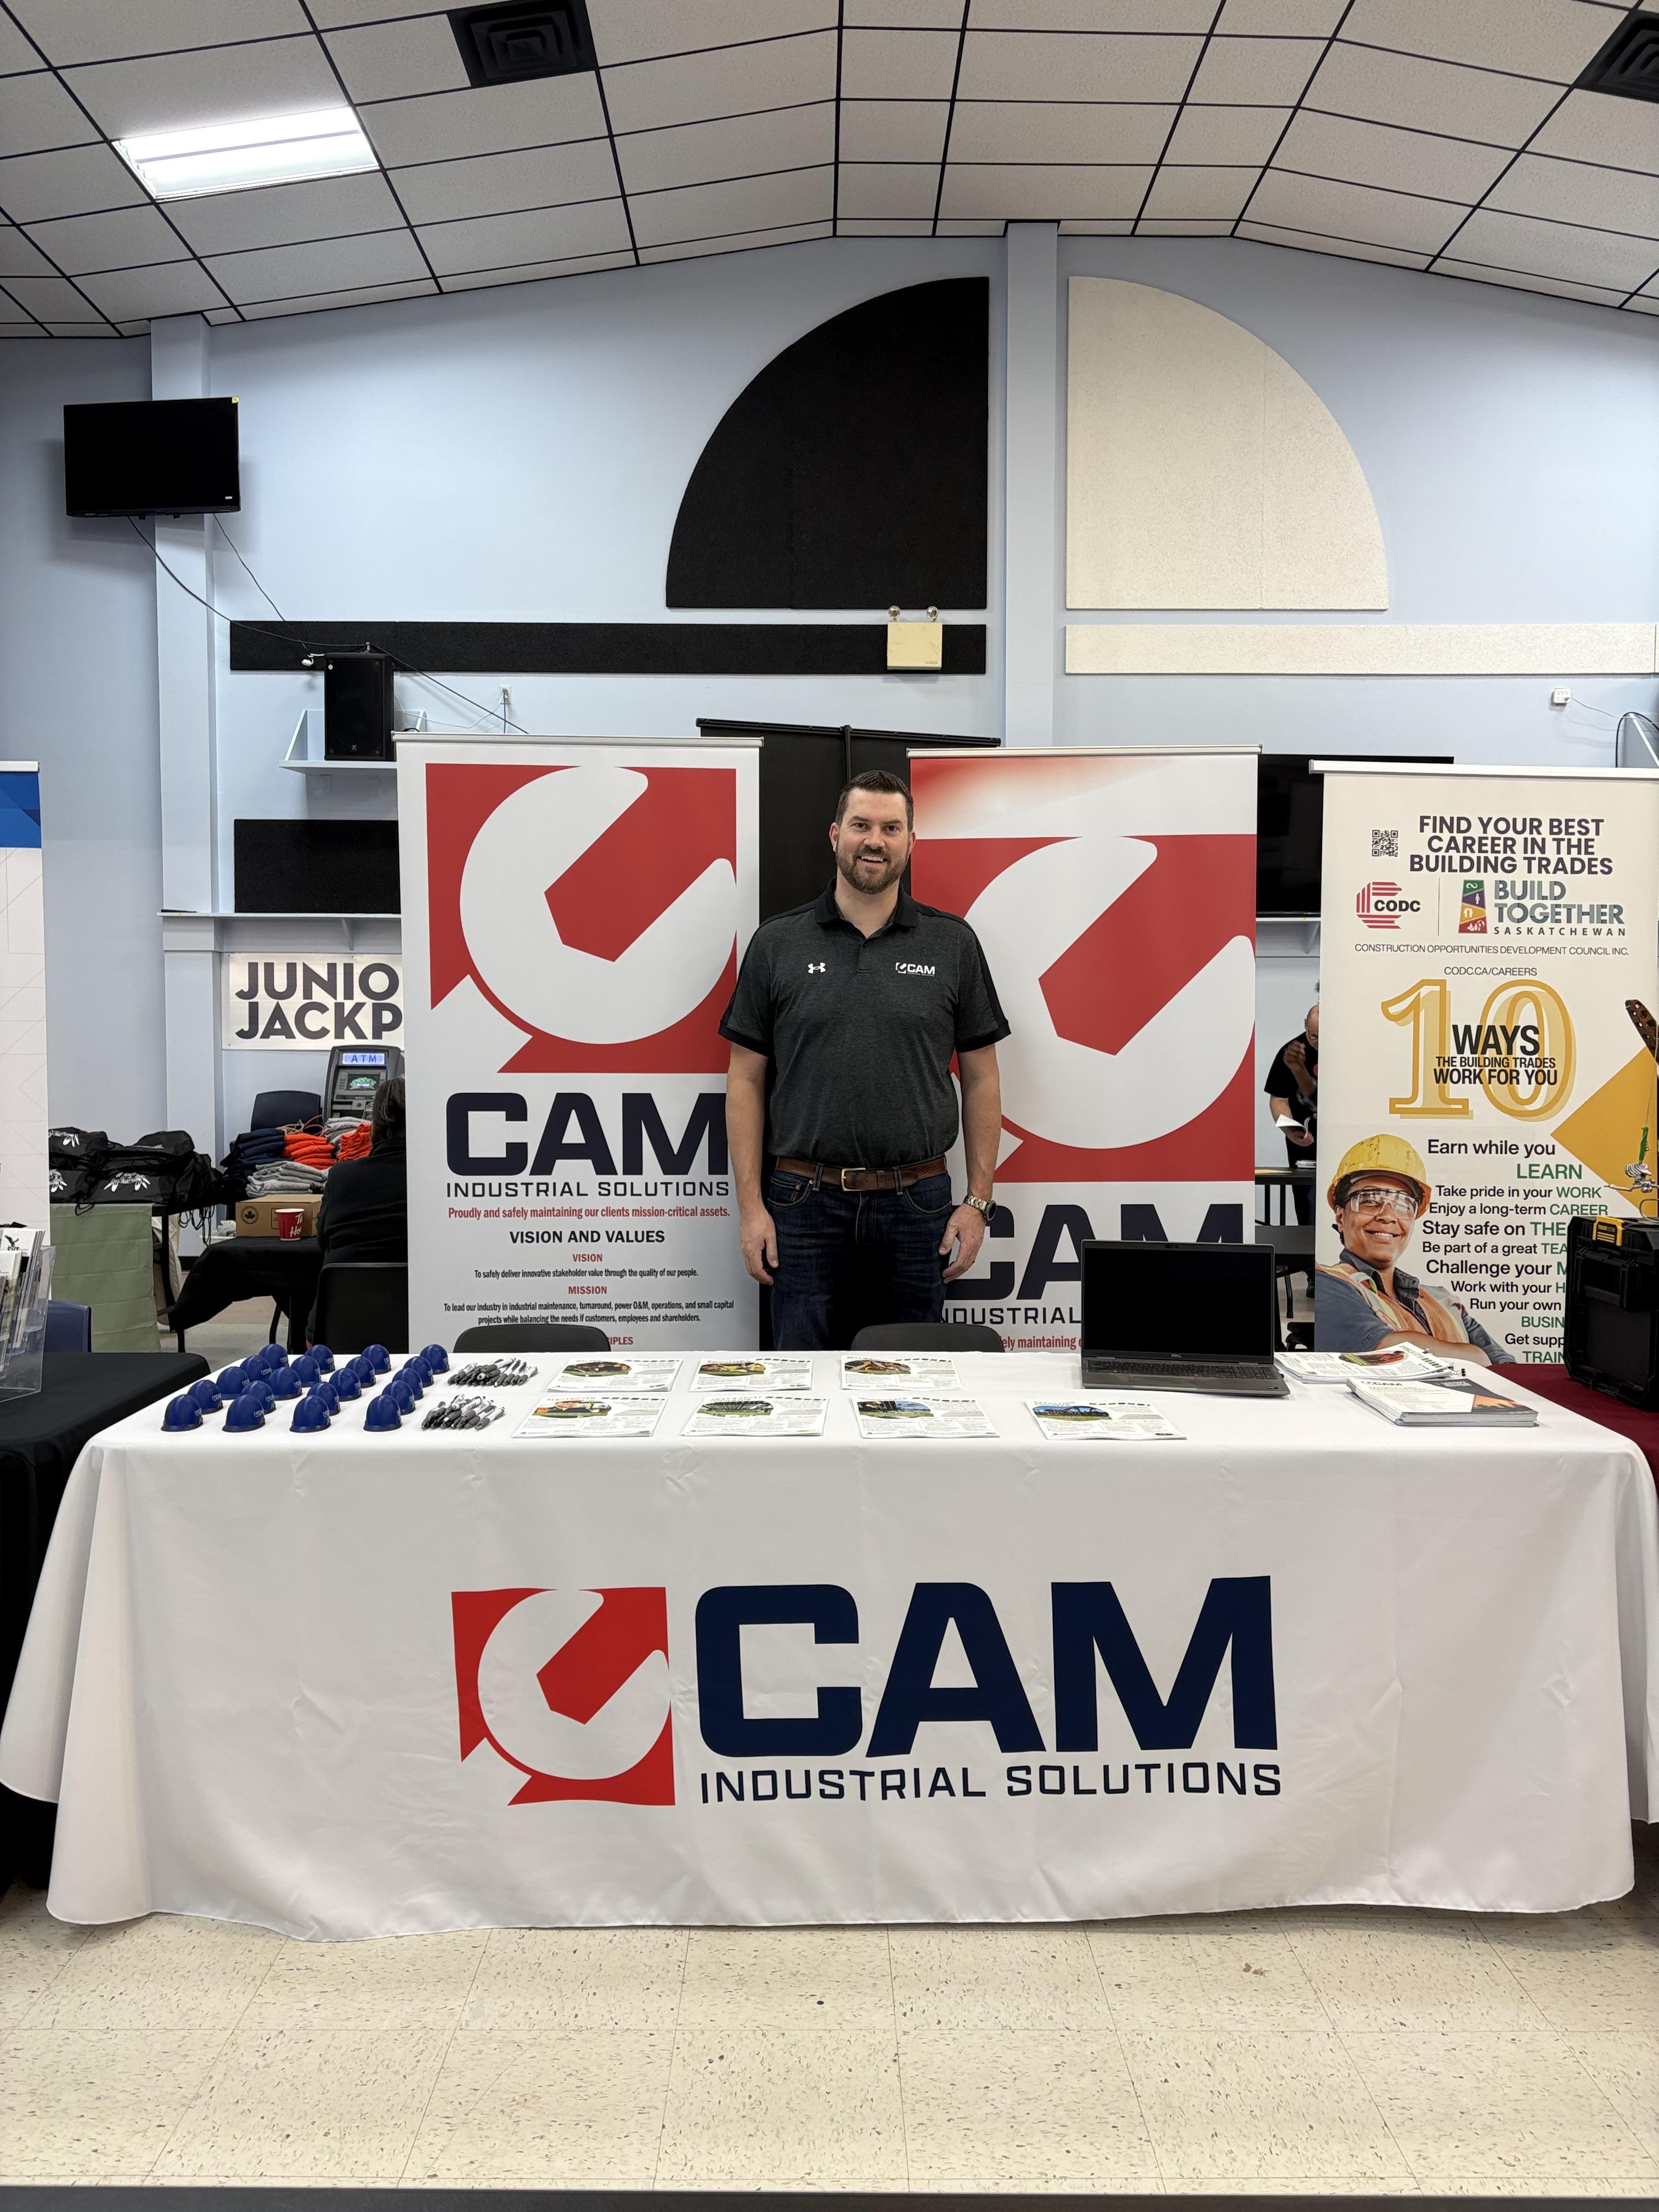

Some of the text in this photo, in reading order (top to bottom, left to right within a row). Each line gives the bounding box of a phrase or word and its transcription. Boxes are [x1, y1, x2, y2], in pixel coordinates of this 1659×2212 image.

[1420, 816, 1604, 836] FIND YOUR BEST
[1427, 836, 1595, 855] CAREER IN THE
[1410, 854, 1612, 874] BUILDING TRADES
[1494, 880, 1566, 900] BUILD
[1374, 900, 1421, 912] CODC
[1494, 903, 1625, 924] TOGETHER
[1494, 927, 1626, 936] SASKATCHEWAN
[1355, 944, 1629, 956] CONSTRUCTION OPPORTUNITIES DEVELOPMENT COUNCIL INC.
[907, 964, 935, 974] CAM
[1444, 967, 1537, 976] CODC.CA/CAREERS
[235, 962, 399, 1001] JUNIO
[235, 1001, 403, 1040] JACKP
[1452, 1025, 1540, 1056] WAYS
[1436, 1057, 1556, 1068] THE BUILDING TRADES
[1434, 1069, 1558, 1085] WORK FOR YOU
[446, 1093, 729, 1176] CAM
[1428, 1139, 1555, 1159] Earn while you
[1516, 1164, 1582, 1180] LEARN
[447, 1182, 729, 1197] INDUSTRIAL SOLUTIONS
[1436, 1186, 1602, 1200] Take pride in your WORK
[448, 1206, 730, 1220] Proudly and safely maintaining our clients mission-critical assets.
[1429, 1203, 1465, 1216] Enjoy
[1480, 1203, 1546, 1217] long-term
[1550, 1204, 1608, 1215] CAREER
[1423, 1221, 1566, 1238] Stay safe on THE
[509, 1231, 665, 1243] VISION AND VALUES
[1423, 1242, 1440, 1253] Be
[1444, 1242, 1471, 1255] part
[1474, 1242, 1487, 1254] of
[1502, 1243, 1537, 1256] great
[482, 1269, 500, 1279] safely
[501, 1269, 521, 1278] deliver
[522, 1269, 551, 1277] innovative
[552, 1268, 587, 1277] stakeholder
[605, 1268, 627, 1278] through
[628, 1268, 637, 1277] the
[639, 1268, 658, 1278] quality
[659, 1268, 666, 1276] of
[677, 1268, 699, 1278] people.
[1426, 1260, 1510, 1277] Challenge
[1515, 1264, 1552, 1278] your
[568, 1286, 607, 1294] MISSION
[1451, 1281, 1486, 1292] Work
[1490, 1282, 1519, 1293] with
[1522, 1284, 1551, 1295] your
[452, 1303, 465, 1311] lead
[477, 1303, 501, 1312] industry
[502, 1302, 507, 1311] in
[509, 1302, 537, 1311] industrial
[538, 1302, 578, 1311] maintenance,
[651, 1301, 684, 1310] operations,
[697, 1300, 713, 1309] small
[714, 1300, 733, 1310] capital
[1470, 1299, 1561, 1312] Run your own
[478, 1316, 502, 1325] projects
[520, 1315, 549, 1323] balancing
[585, 1314, 617, 1323] customers,
[618, 1314, 648, 1323] employees
[662, 1313, 701, 1322] shareholders.
[1000, 1336, 1015, 1351] ely
[1018, 1336, 1076, 1350] maintaining
[1505, 1334, 1530, 1345] Get
[695, 1576, 1277, 1757] CAM
[701, 1763, 1281, 1804] INDUSTRIAL SOLUTIONS
